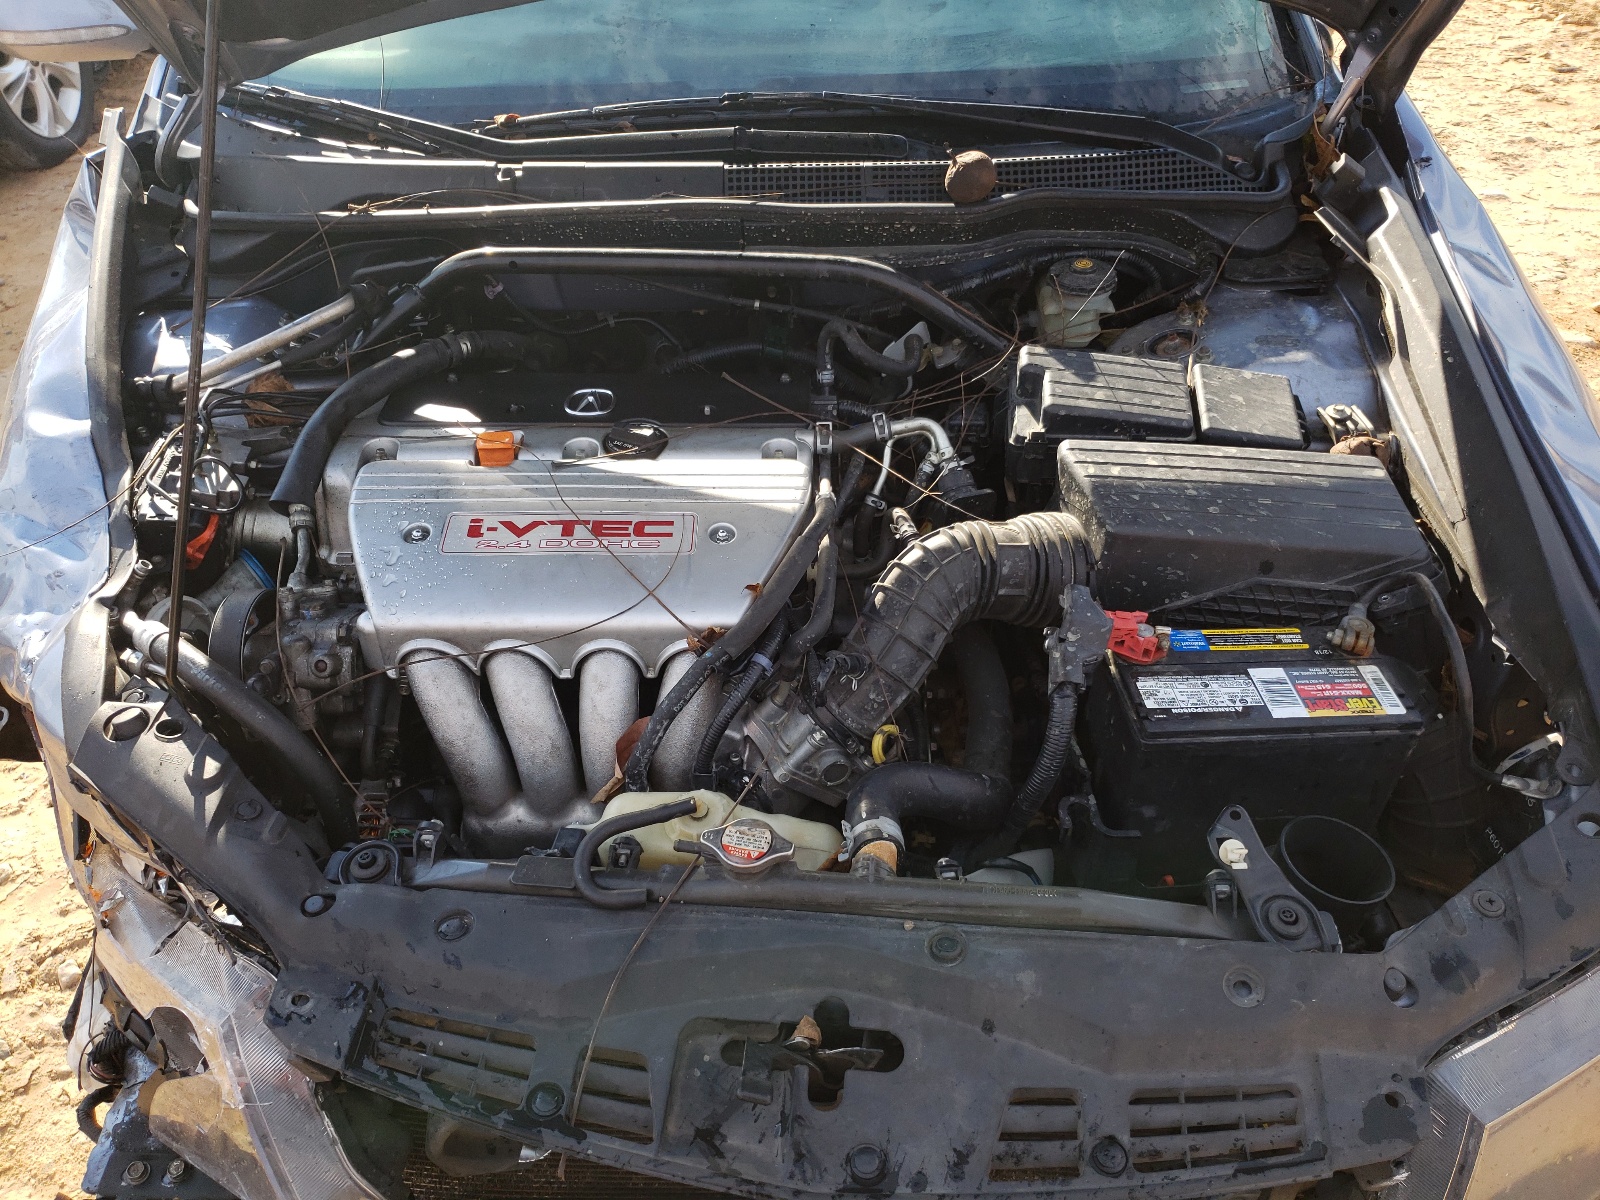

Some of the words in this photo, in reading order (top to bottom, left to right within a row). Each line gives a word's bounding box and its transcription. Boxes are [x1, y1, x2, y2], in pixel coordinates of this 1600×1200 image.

[466, 518, 675, 538] i-VTEC
[474, 538, 531, 549] 2.4
[537, 538, 661, 549] DOHC
[1171, 706, 1235, 714] DANGER/POISON
[1303, 697, 1382, 713] EverStart
